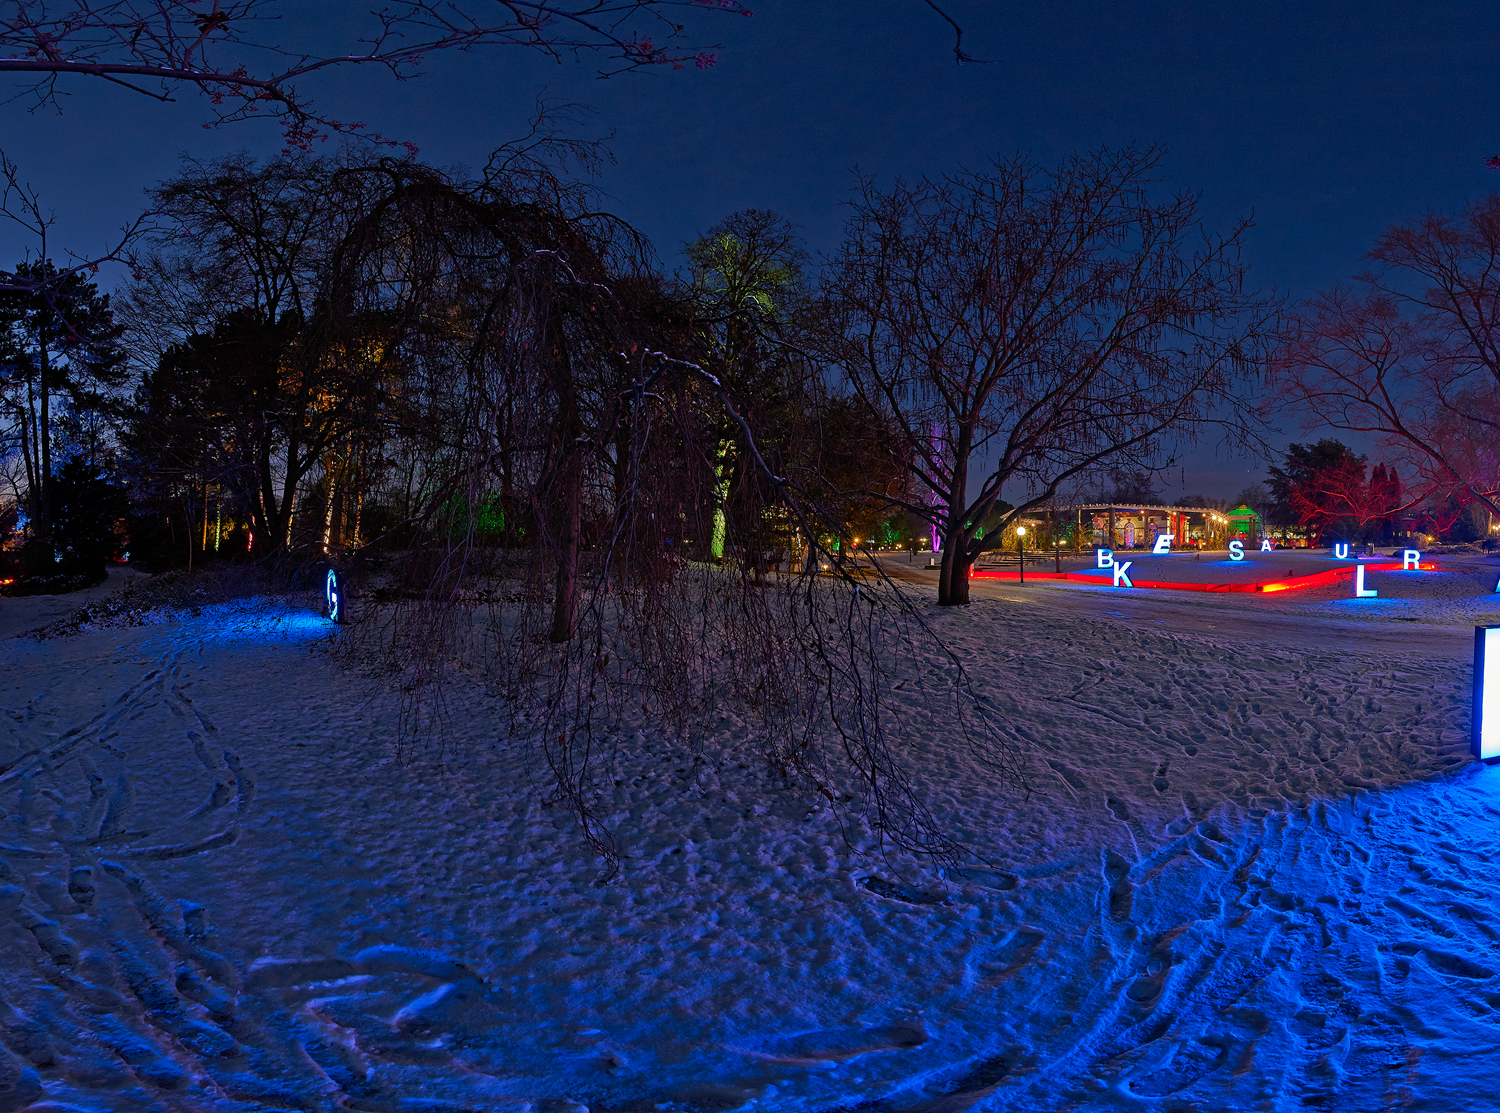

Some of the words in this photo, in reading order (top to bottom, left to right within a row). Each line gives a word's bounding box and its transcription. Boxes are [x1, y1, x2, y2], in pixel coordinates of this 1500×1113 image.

[1153, 534, 1175, 554] E
[1228, 540, 1245, 561] S
[1261, 539, 1272, 552] A
[1335, 543, 1348, 559] U
[1097, 548, 1114, 568] B
[1403, 549, 1421, 570] R
[1113, 561, 1134, 587] K
[1356, 564, 1378, 597] L
